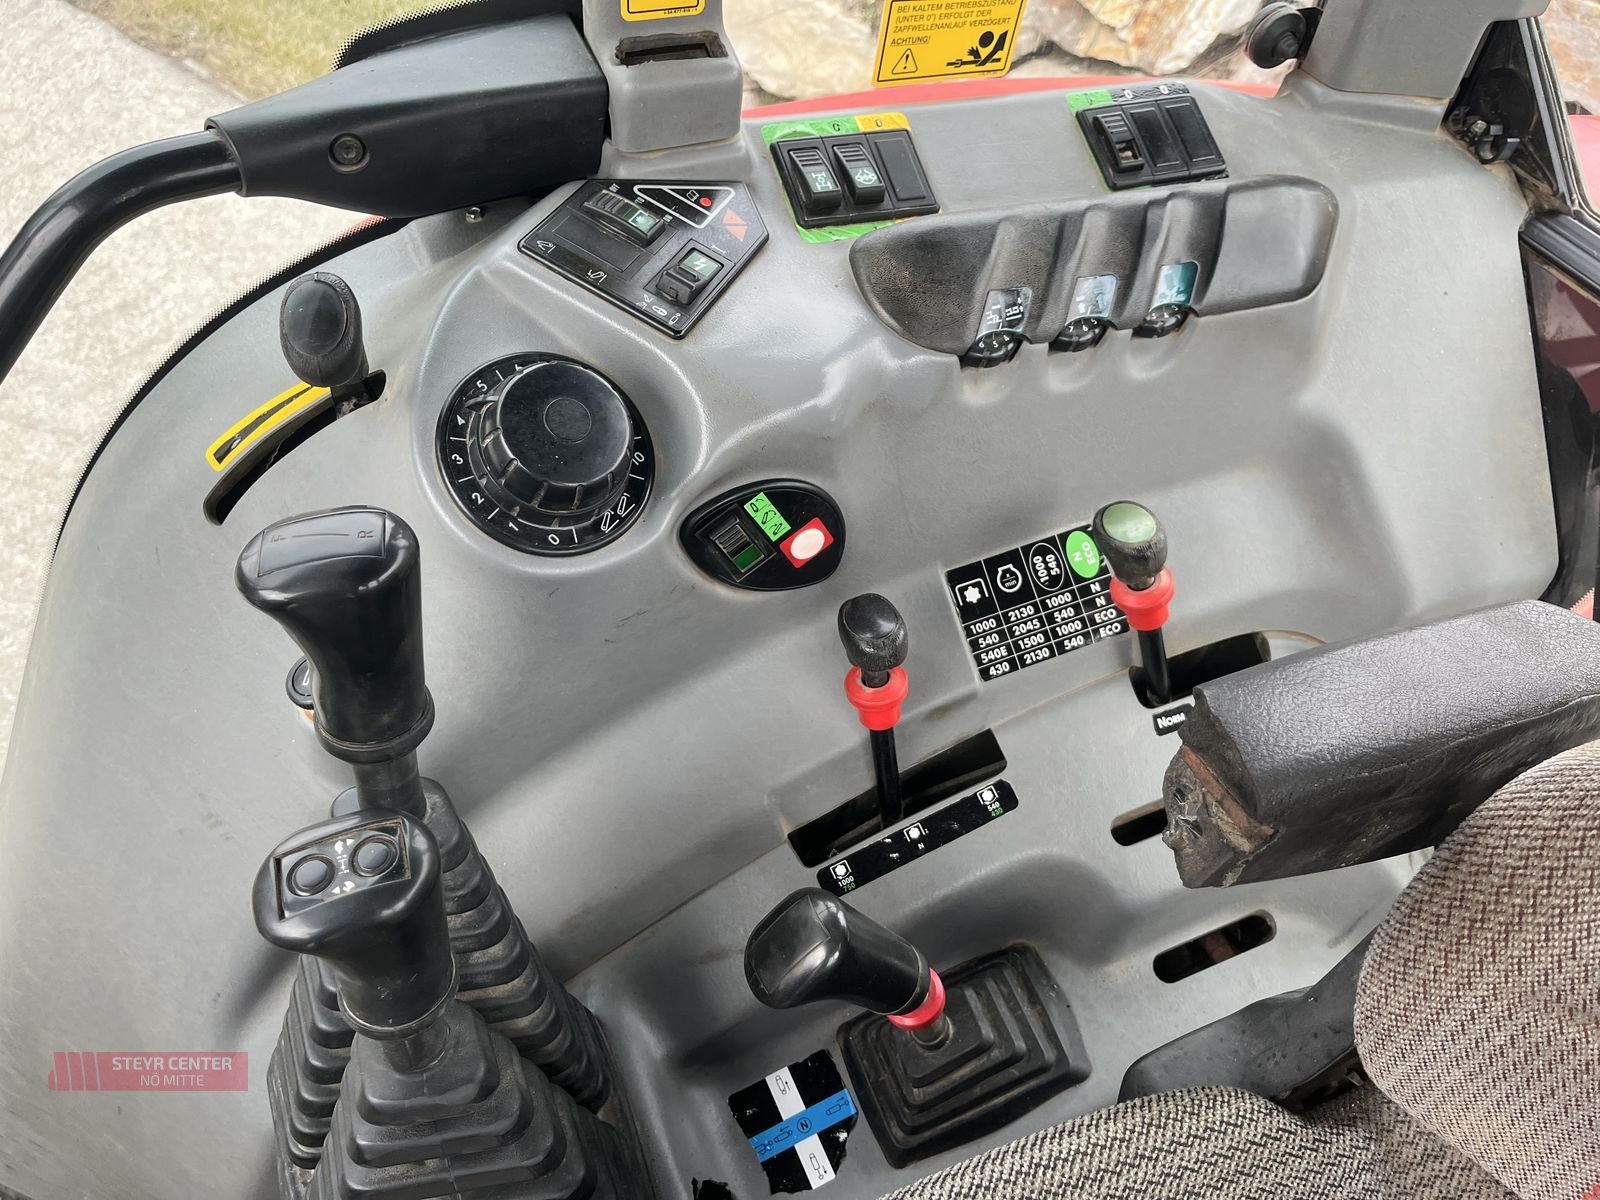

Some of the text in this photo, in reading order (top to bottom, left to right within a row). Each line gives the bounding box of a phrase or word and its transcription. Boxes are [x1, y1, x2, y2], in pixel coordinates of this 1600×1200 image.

[897, 0, 1016, 13] BEI KALTEM BETRIEBSZUSTAND
[895, 14, 925, 24] (UNTER
[938, 10, 974, 20] ERFOLGT
[976, 9, 992, 17] DER
[893, 17, 1012, 33] ZAPFWELLENANLAUF VERZÖGERT
[890, 36, 931, 46] ACHTUNG!
[476, 380, 488, 392] 5
[456, 415, 466, 426] 4
[451, 454, 464, 465] 3
[632, 451, 645, 466] 10
[471, 492, 485, 505] 2
[508, 521, 519, 532] 1
[548, 533, 560, 545] 0
[1072, 552, 1083, 562] N
[1081, 541, 1097, 565] ECO
[1033, 555, 1050, 584] 1000
[1046, 554, 1061, 576] 540
[969, 581, 1102, 634] 1000 2130 1000 N
[978, 595, 1107, 649] 540 2045 540 N
[980, 608, 1117, 663] 540E 1500 1000 ECO
[988, 623, 1122, 677] 430 2130 540 ECO
[987, 801, 1000, 812] 540
[918, 842, 925, 850] N
[838, 876, 854, 888] 1000
[800, 1120, 809, 1130] N
